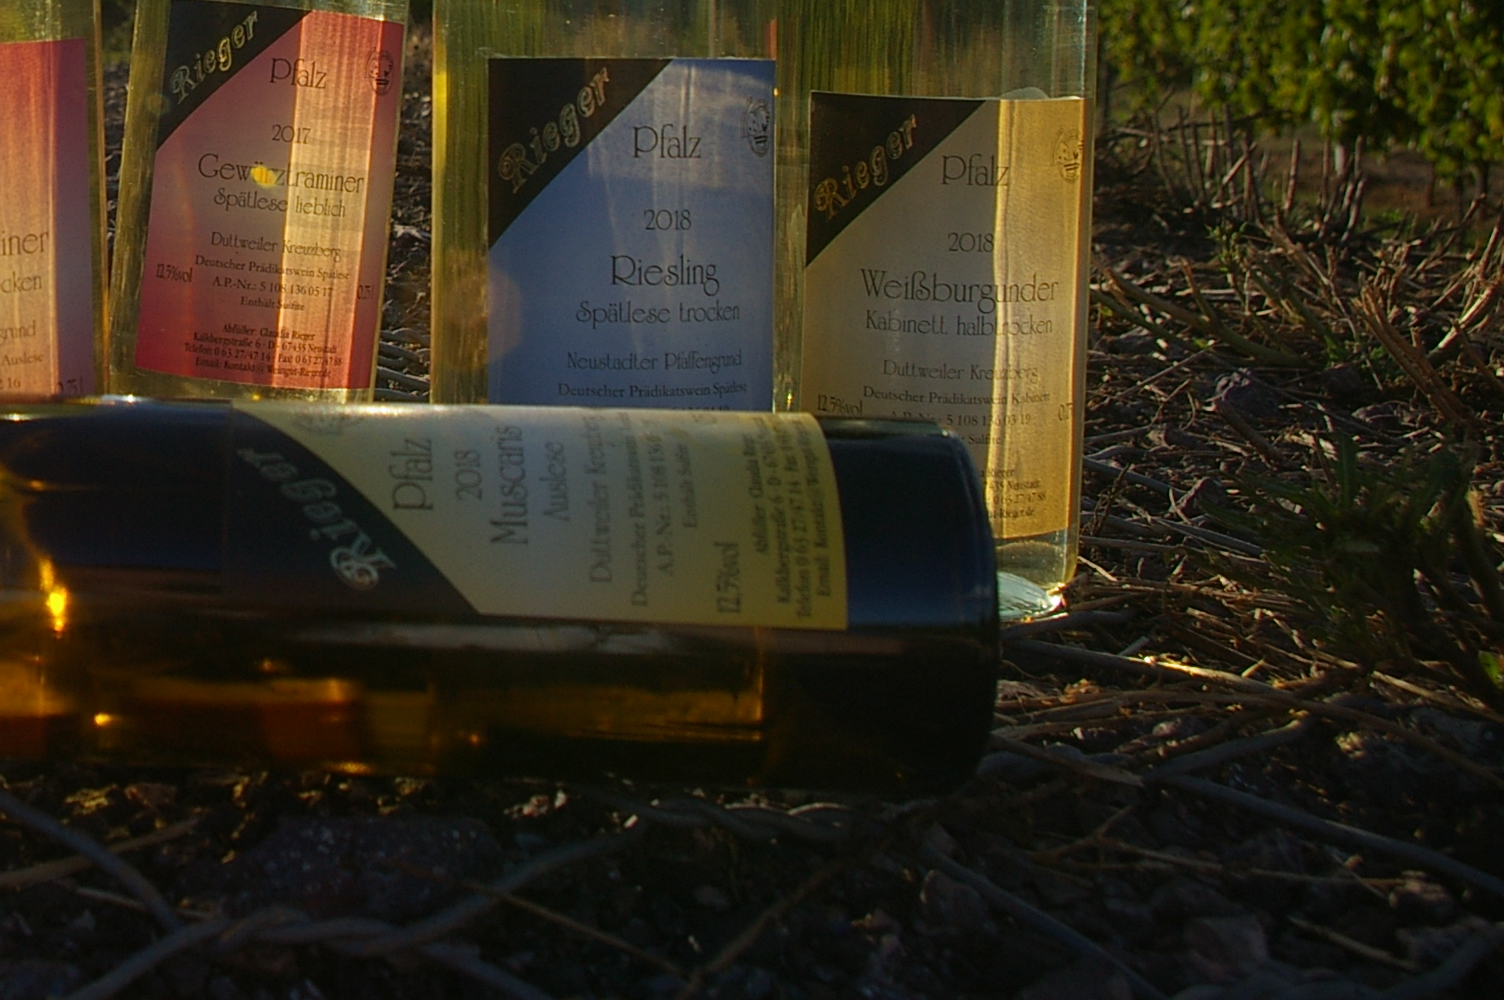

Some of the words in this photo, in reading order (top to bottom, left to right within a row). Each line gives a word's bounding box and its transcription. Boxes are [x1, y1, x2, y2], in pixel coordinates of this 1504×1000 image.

[171, 10, 259, 105] Rieger
[270, 57, 328, 91] Pfalz
[272, 124, 312, 145] 2017
[499, 66, 611, 194] Rieger
[632, 123, 702, 159] Pfalz
[198, 153, 365, 194] Gewürztraminer
[814, 114, 917, 220] Rieger
[940, 153, 1010, 187] Pfalz
[213, 187, 288, 213] Spätlese
[295, 194, 347, 218] lieblich
[643, 208, 693, 231] 2018
[211, 231, 279, 254] Duttweiler
[283, 240, 342, 264] Kreuzberg
[947, 232, 995, 254] 2018
[195, 255, 246, 271] Deutscher
[610, 253, 721, 297] Riesling
[259, 281, 267, 292] 5
[859, 268, 1059, 315] Weißburgunder
[575, 301, 672, 330] Spätlese
[679, 301, 741, 323] trocken
[865, 309, 947, 336] Kabinett
[956, 314, 1053, 337] halbtrocken
[664, 348, 742, 374] Pfaffengrund
[883, 359, 965, 381] Duttweiler
[557, 383, 624, 398] Deutscher
[629, 384, 710, 398] Prädikatswein
[862, 385, 925, 404] Deutscher
[957, 413, 979, 427] 108
[388, 437, 434, 512] Pfalz
[453, 448, 483, 502] 2018
[489, 424, 529, 545] Muscaris
[539, 441, 571, 522] Auslese
[236, 447, 396, 591] Rieger
